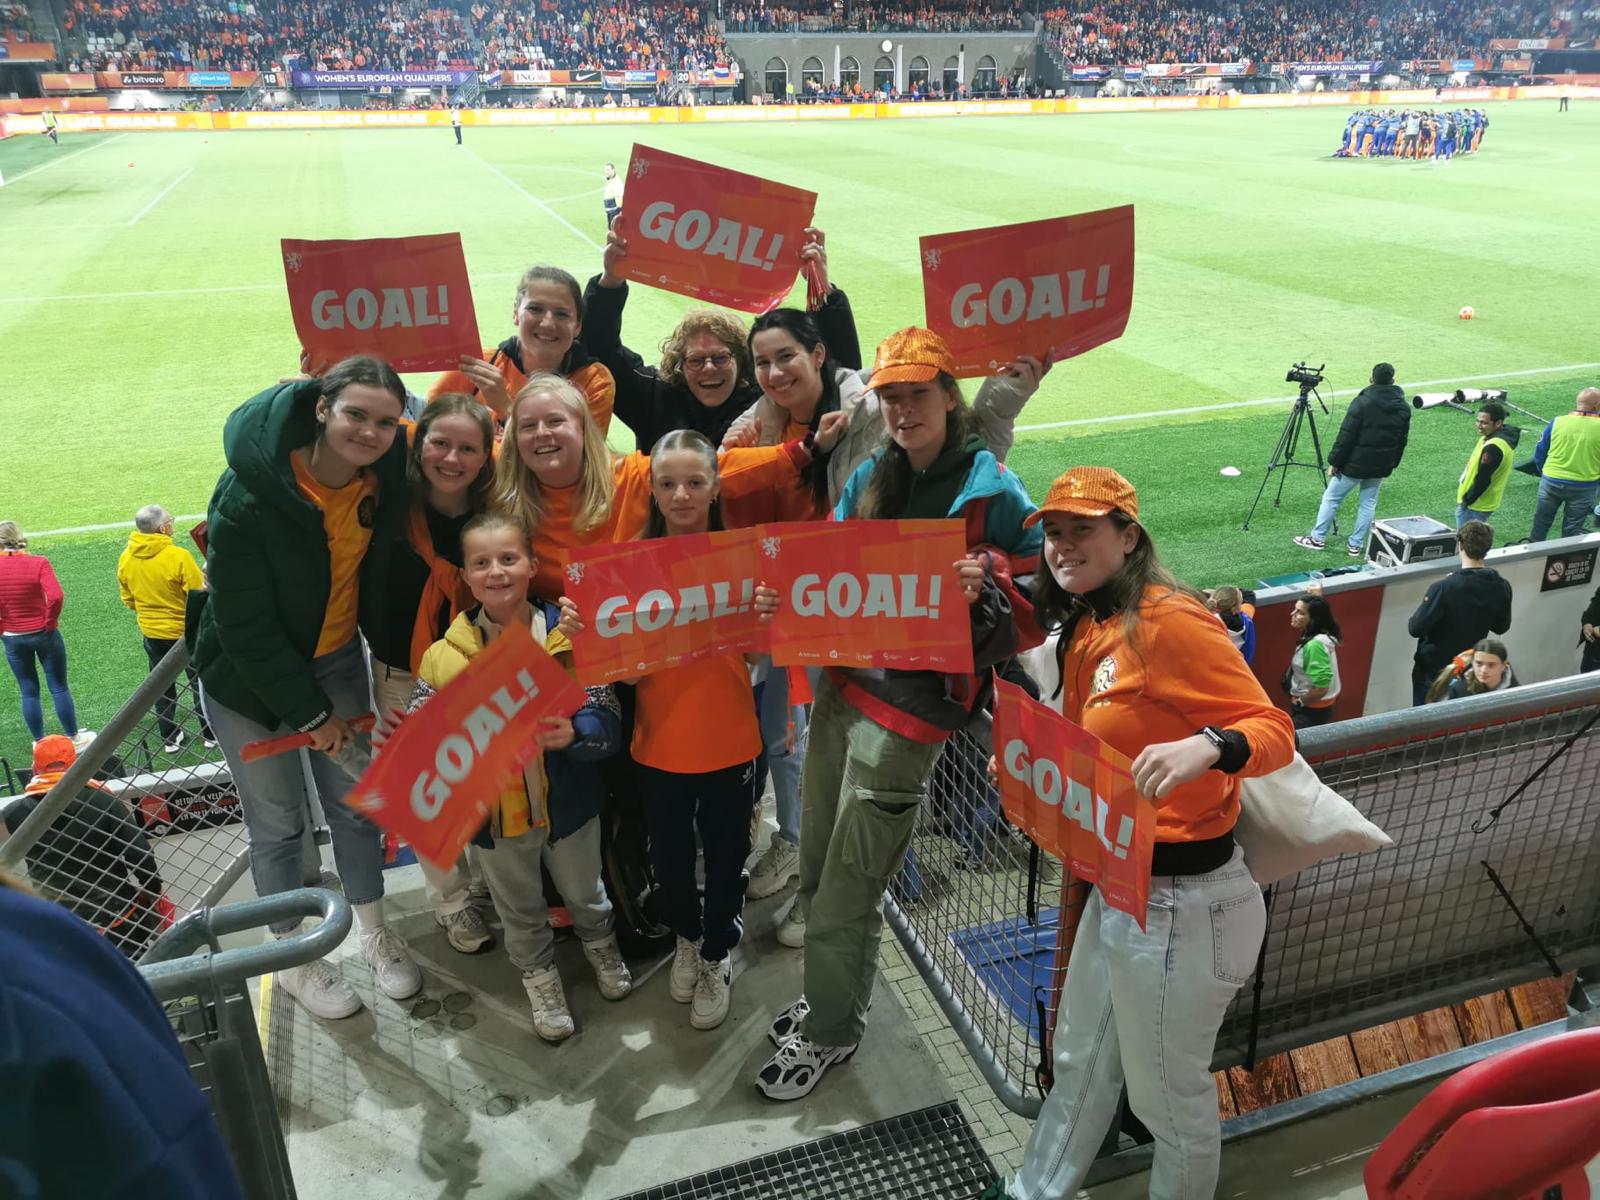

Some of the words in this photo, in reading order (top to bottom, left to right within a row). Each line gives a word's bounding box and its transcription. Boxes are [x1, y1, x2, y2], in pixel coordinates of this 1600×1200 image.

[132, 76, 165, 84] bitvavo
[264, 73, 276, 83] 18
[315, 74, 356, 82] WOMEN'S
[357, 74, 402, 82] EUROPEAN
[404, 74, 452, 82] QUALIFIERS
[516, 73, 535, 82] ING
[678, 72, 689, 81] 20
[639, 201, 785, 272] GOAL!
[311, 284, 449, 330] GOAL!
[951, 264, 1110, 329] GOAL!
[595, 577, 754, 639] GOAL!
[791, 572, 942, 619] GOAL!
[409, 667, 540, 821] GOAL!
[1004, 738, 1134, 860] GOAL!
